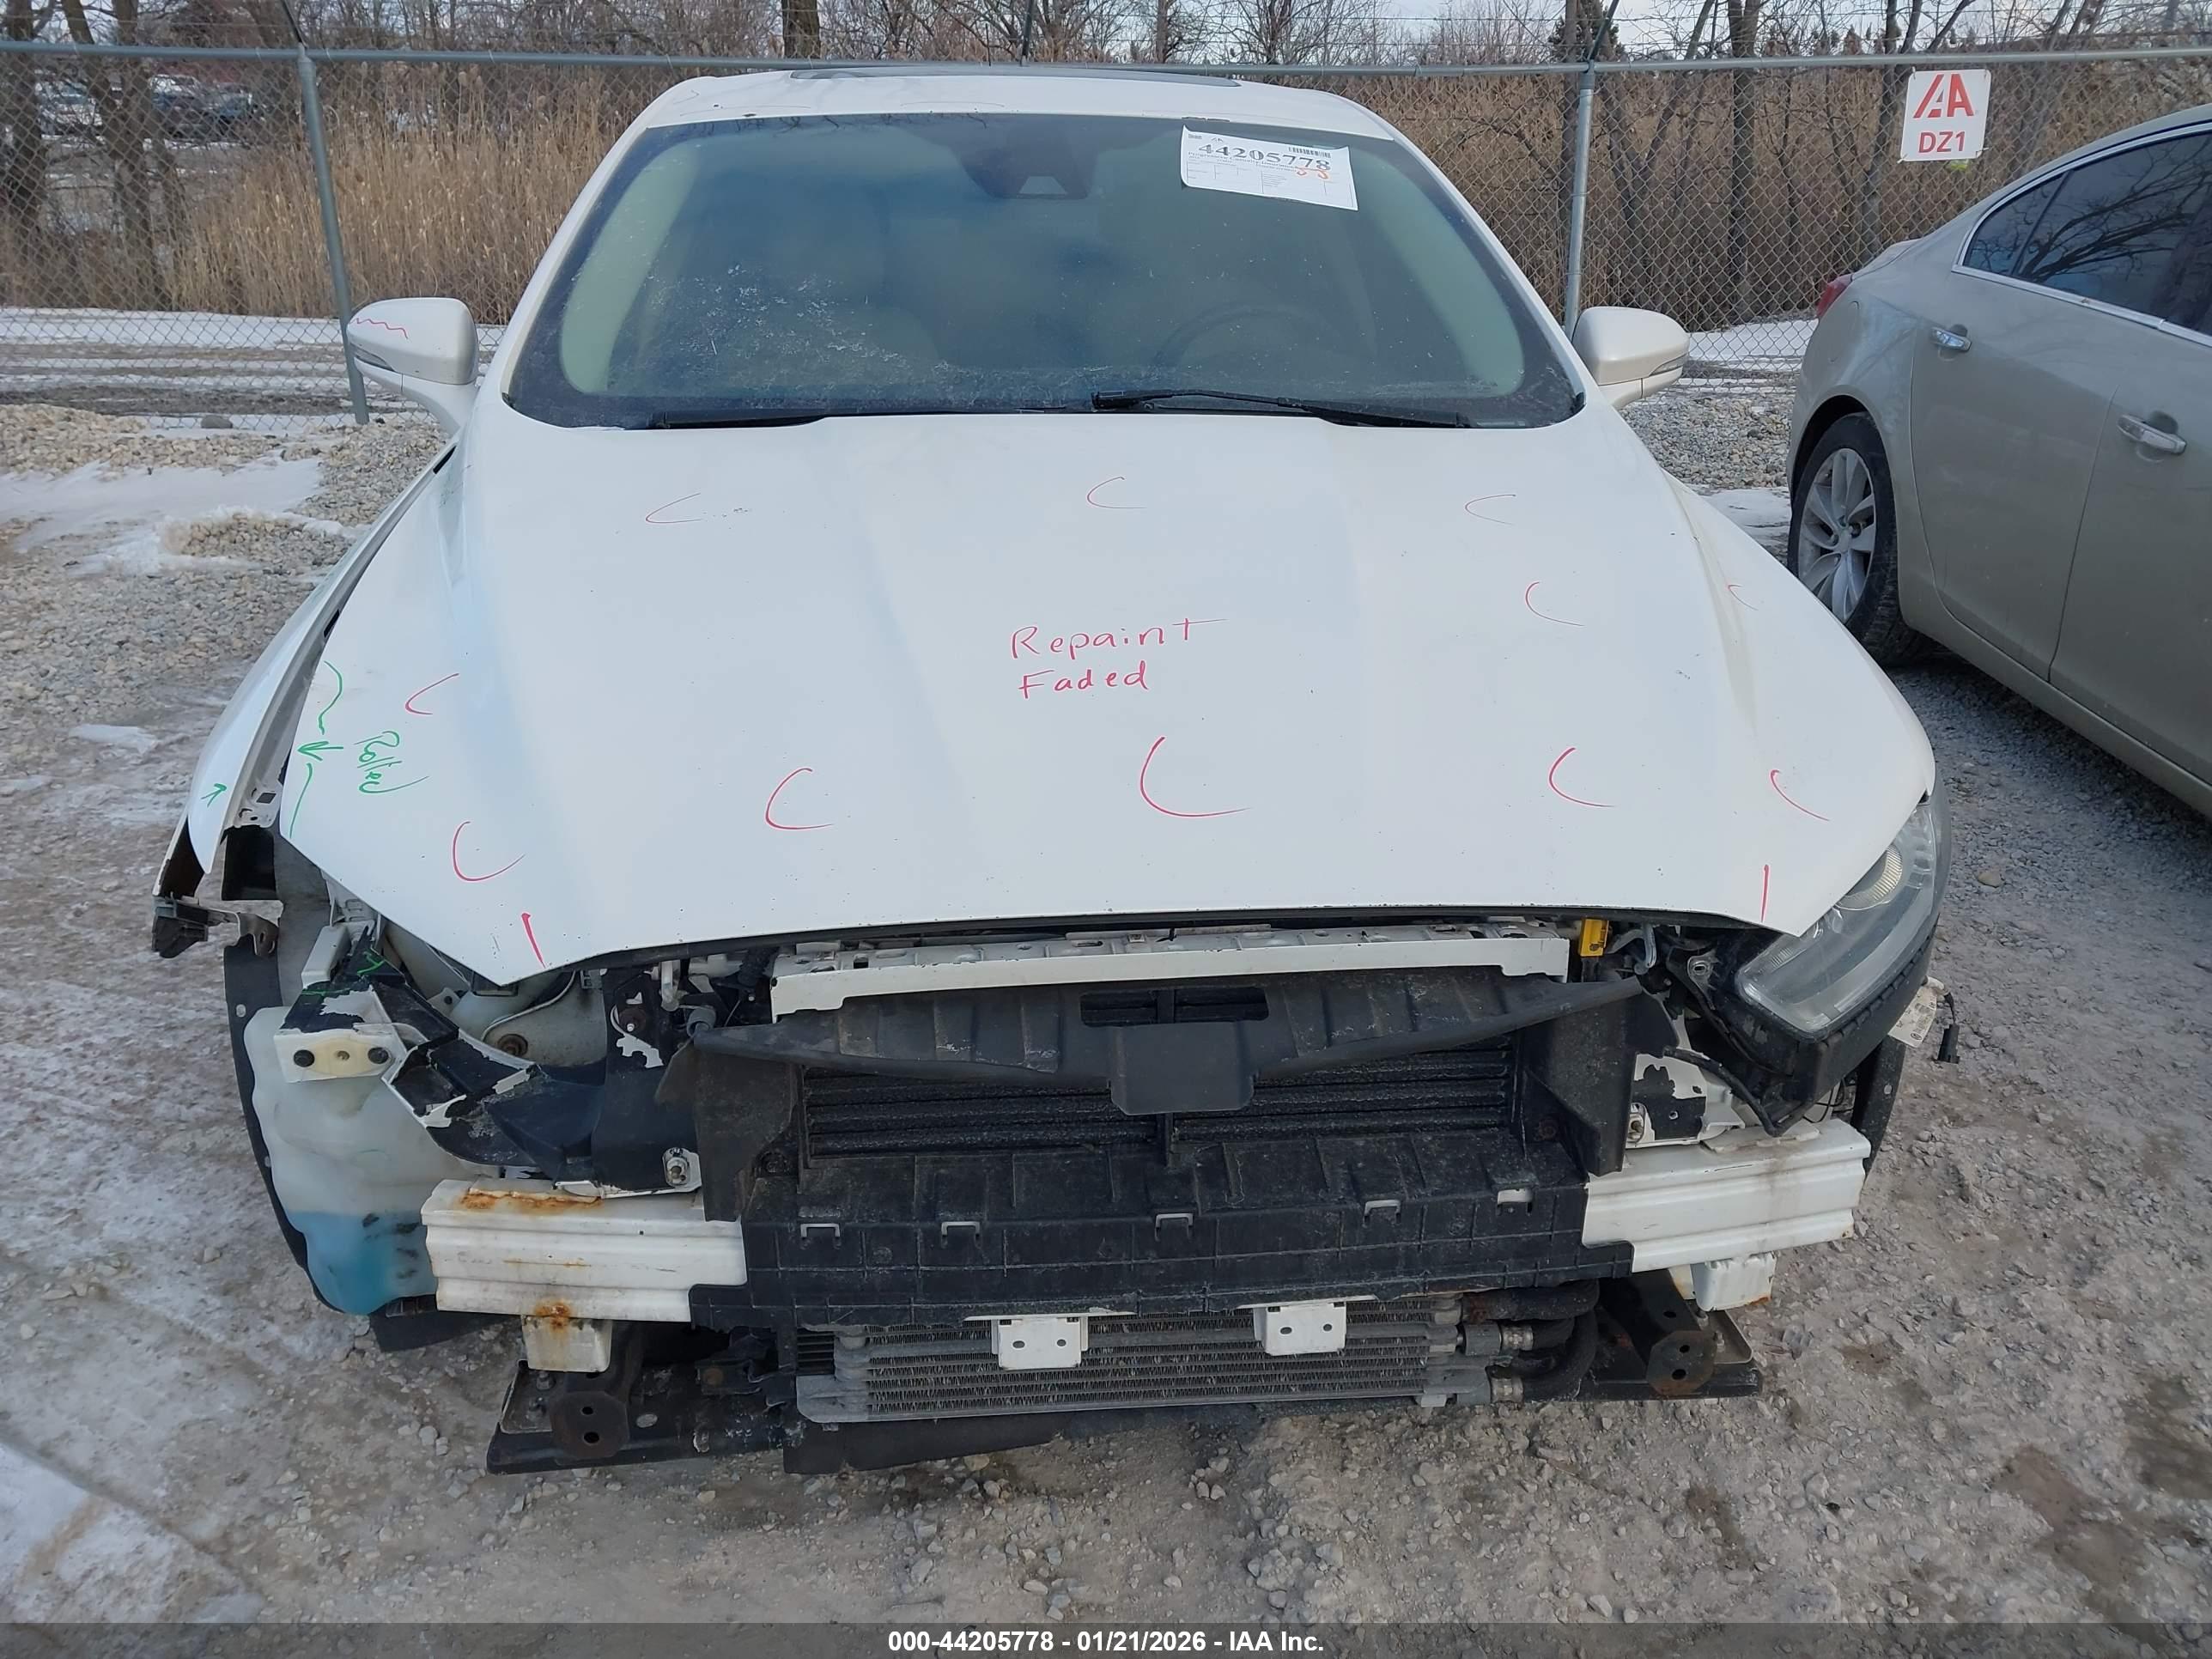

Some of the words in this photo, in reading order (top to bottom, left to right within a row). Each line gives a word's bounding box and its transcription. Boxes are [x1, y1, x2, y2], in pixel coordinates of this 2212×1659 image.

[1198, 143, 1332, 172] 44205778
[1918, 131, 1966, 153] DZ1
[1012, 617, 1228, 660] Repaint
[1018, 659, 1149, 700] Faded
